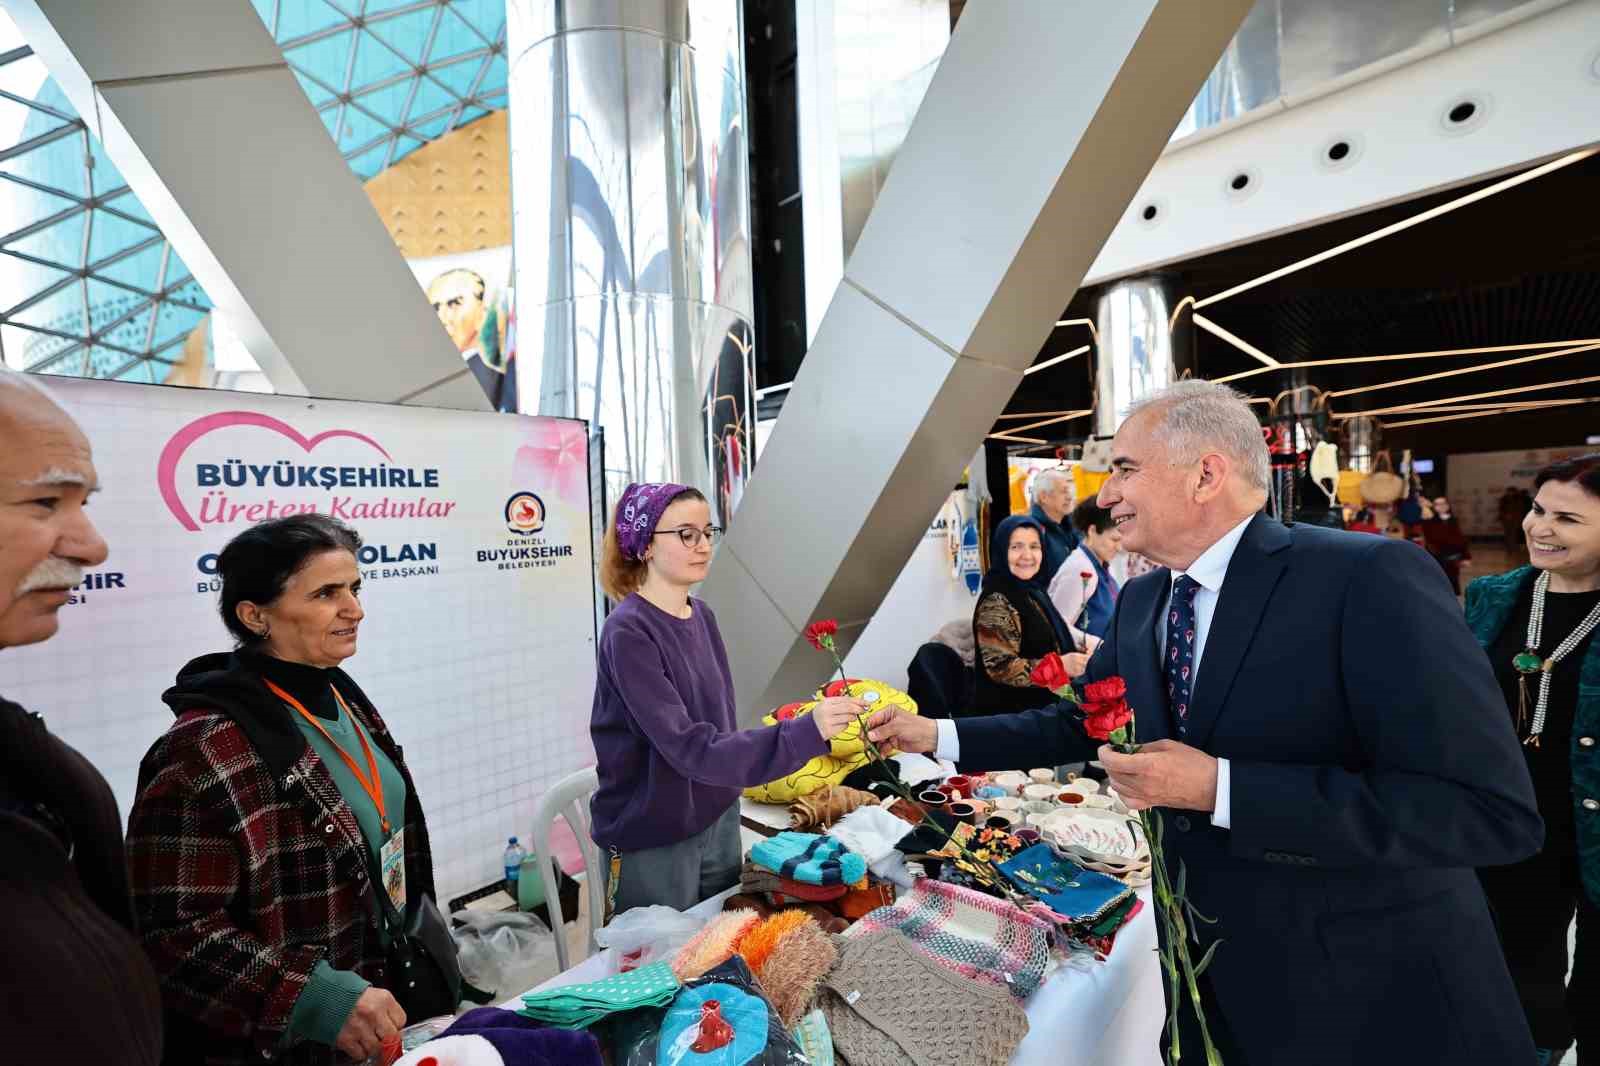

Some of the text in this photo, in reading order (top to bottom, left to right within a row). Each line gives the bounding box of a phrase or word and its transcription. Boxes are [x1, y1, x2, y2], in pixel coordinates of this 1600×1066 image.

[196, 459, 439, 490] BÜYÜKŞEHİRLE
[200, 491, 456, 523] Üreten Kadınlar
[358, 543, 437, 564] OLAN
